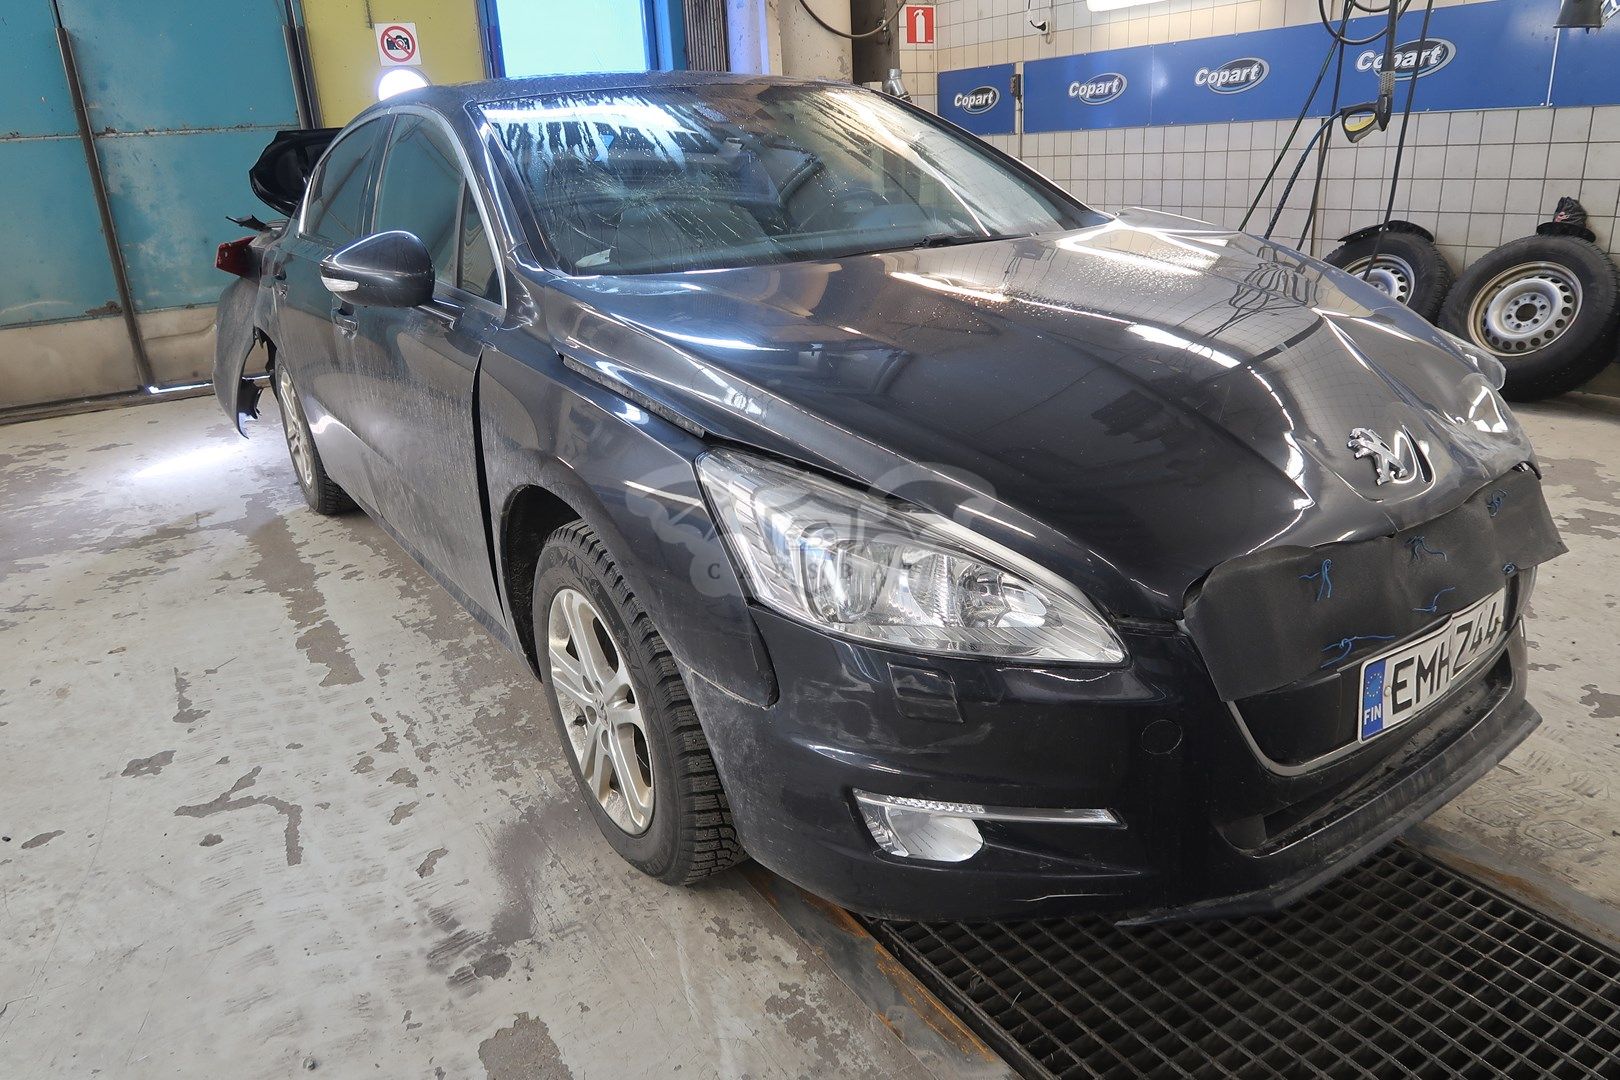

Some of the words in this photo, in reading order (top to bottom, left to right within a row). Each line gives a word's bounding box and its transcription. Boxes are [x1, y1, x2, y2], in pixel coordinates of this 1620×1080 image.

[1195, 64, 1260, 87] Copart
[954, 90, 994, 109] Copart
[1069, 78, 1120, 99] Copart
[1364, 703, 1382, 726] FIN
